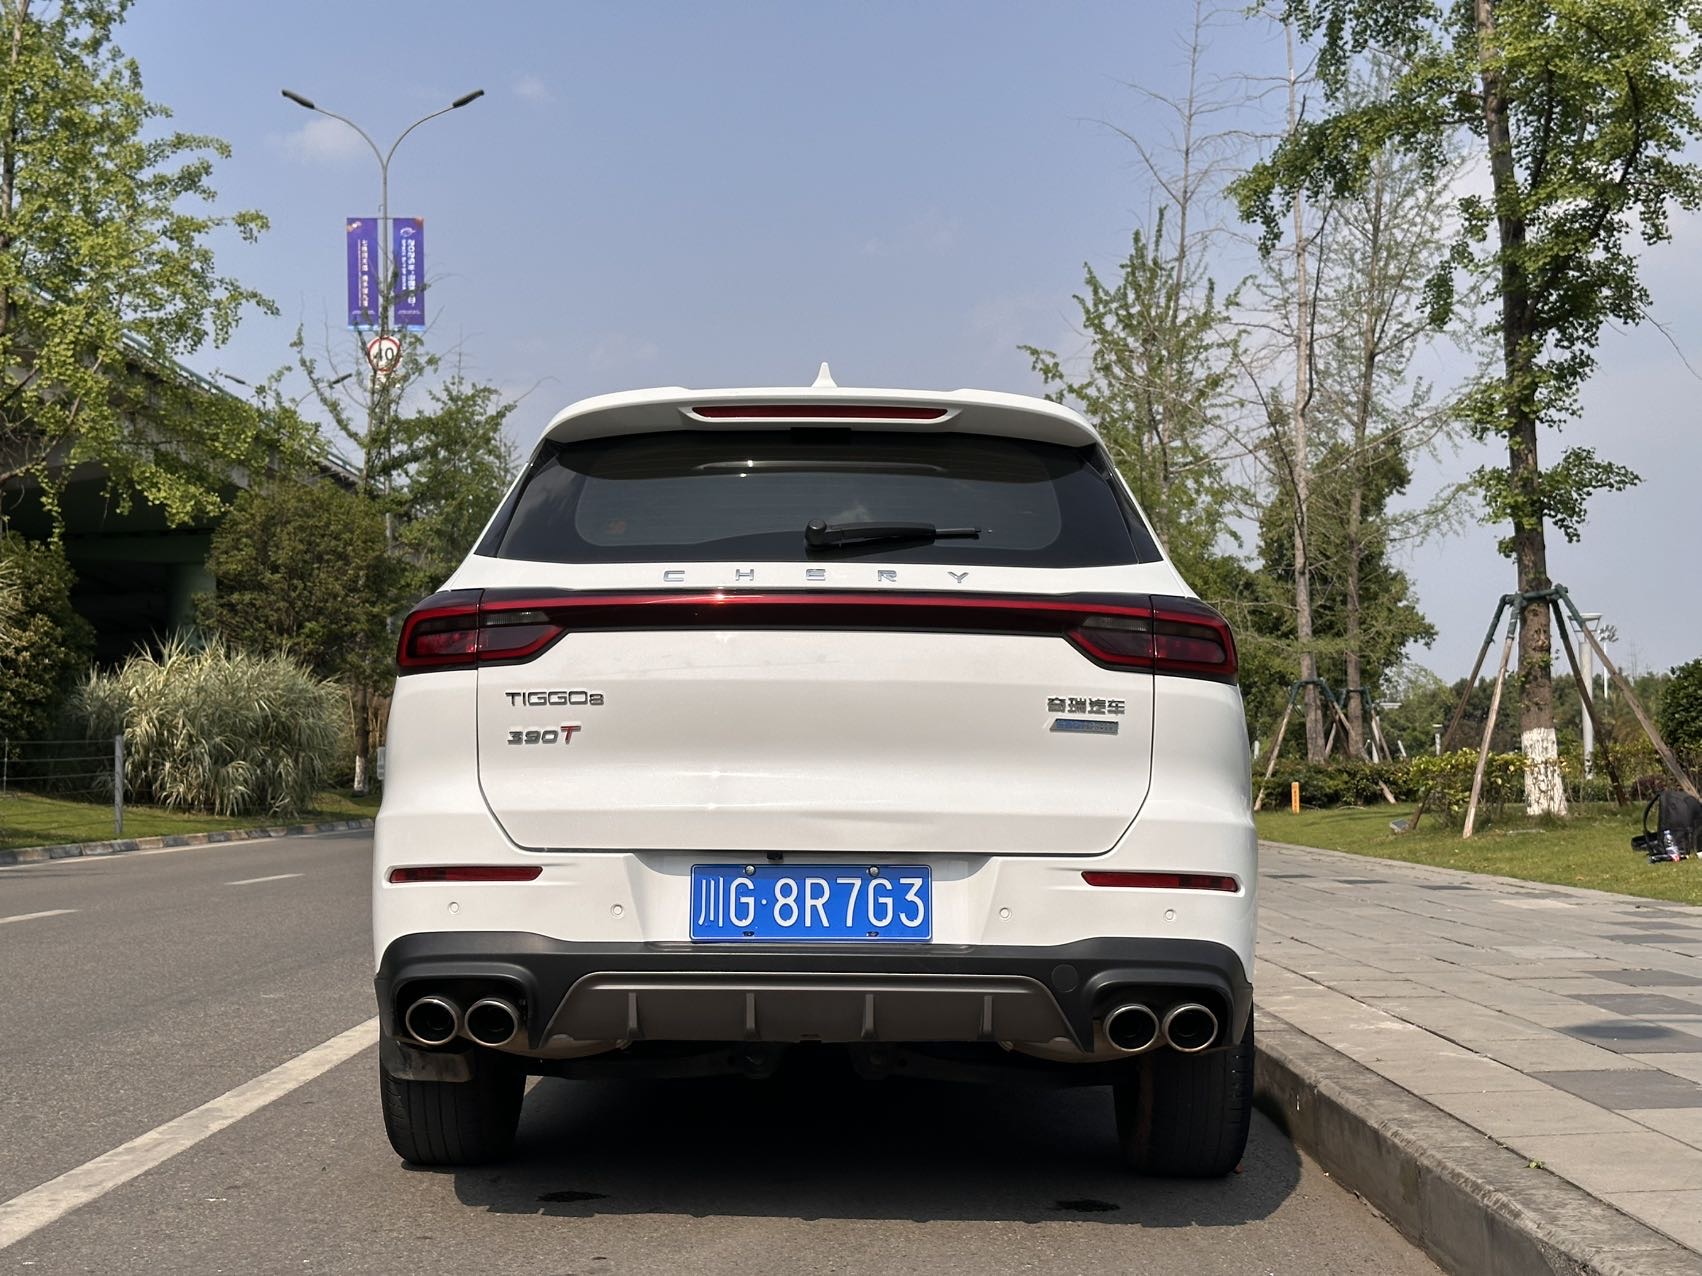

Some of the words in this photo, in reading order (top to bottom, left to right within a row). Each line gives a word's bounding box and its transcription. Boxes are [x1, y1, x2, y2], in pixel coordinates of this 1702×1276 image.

[663, 569, 969, 583] CHERY
[1047, 697, 1125, 716] 奇瑞汽车
